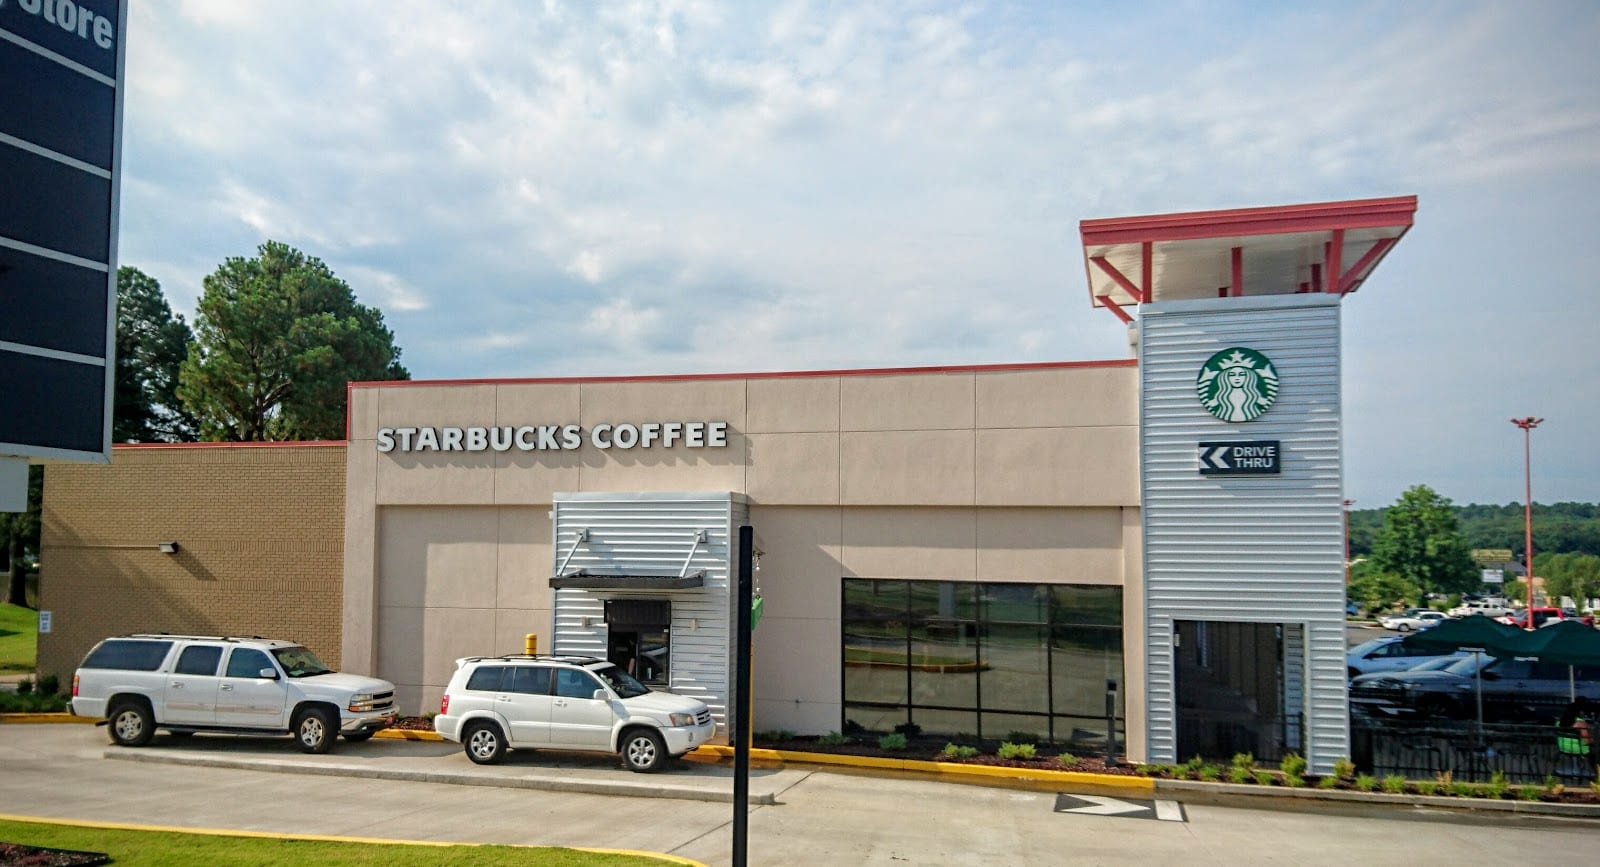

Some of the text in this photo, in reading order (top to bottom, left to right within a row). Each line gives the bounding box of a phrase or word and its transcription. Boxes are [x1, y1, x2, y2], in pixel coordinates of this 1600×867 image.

[377, 421, 727, 452] STARBUCKS COFFEE
[1233, 446, 1276, 457] DRIVE
[1233, 457, 1273, 468] THRU
